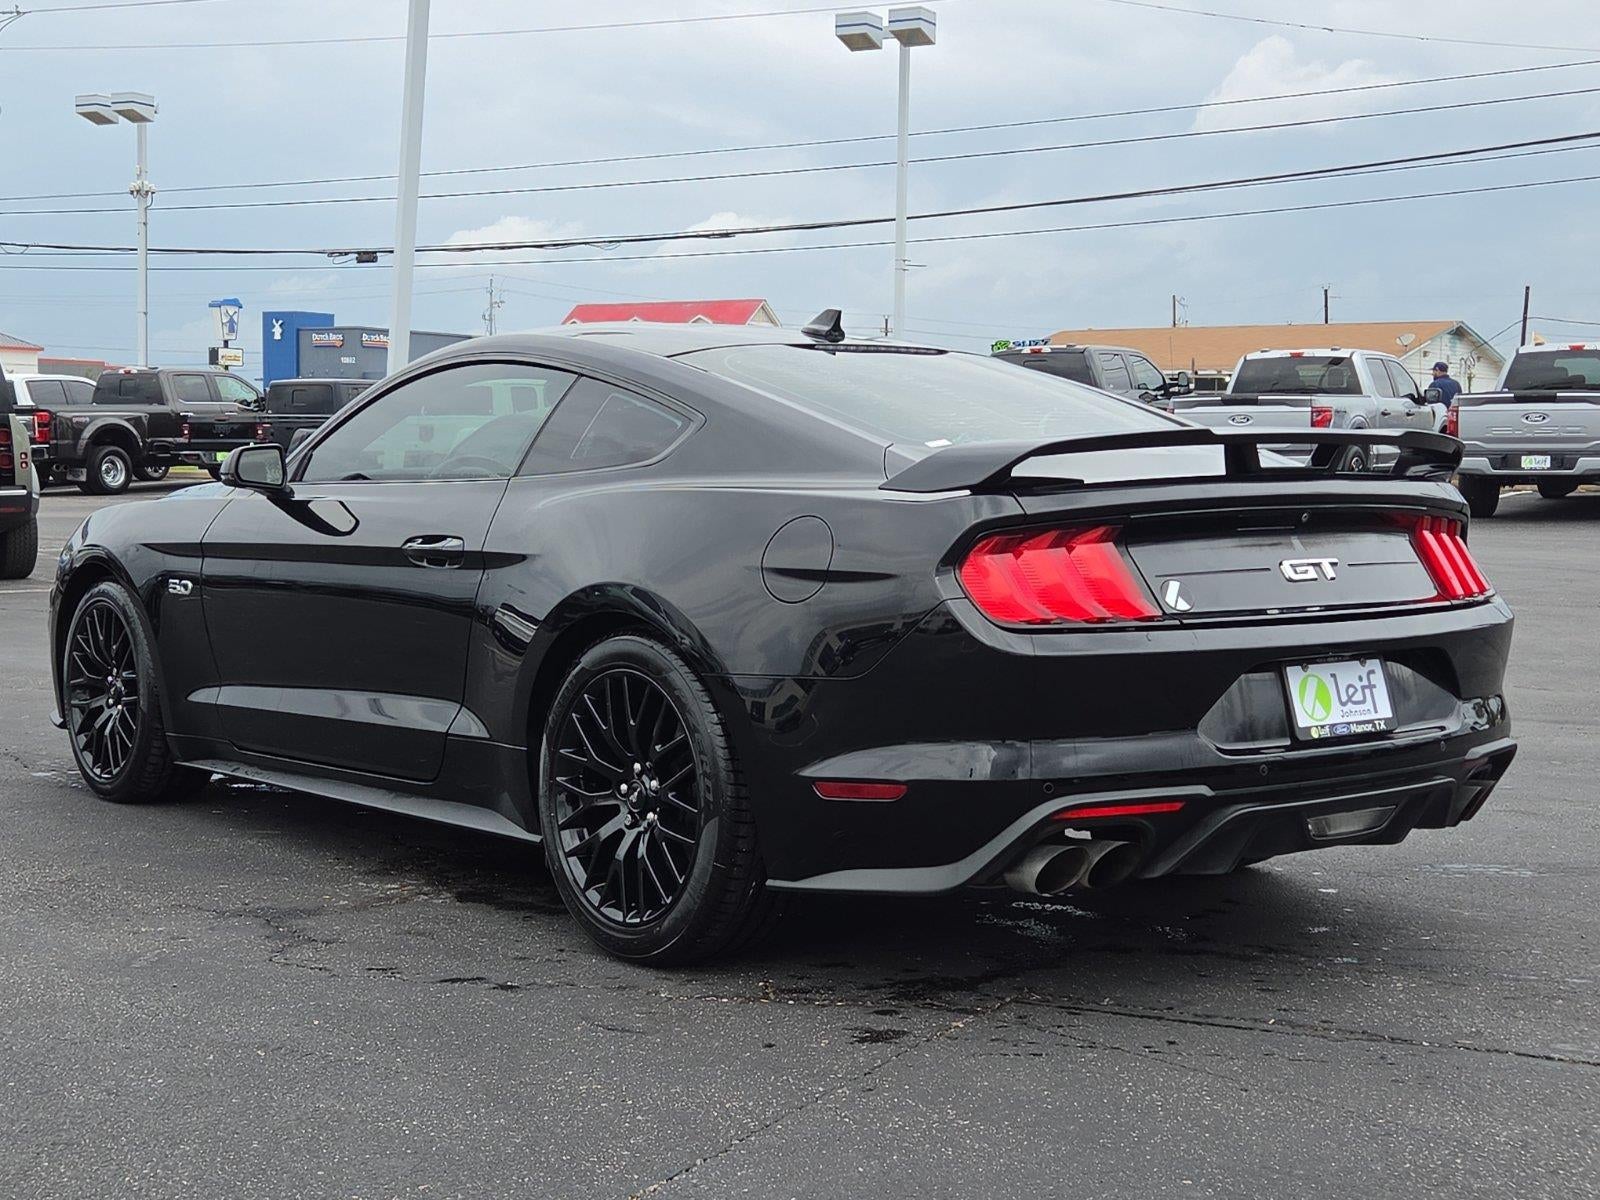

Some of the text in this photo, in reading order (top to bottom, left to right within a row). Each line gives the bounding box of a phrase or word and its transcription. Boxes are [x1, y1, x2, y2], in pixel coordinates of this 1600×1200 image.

[1279, 558, 1339, 582] GT
[1340, 708, 1372, 718] Johnson
[1334, 725, 1349, 733] Ford
[1350, 723, 1374, 733] Manor,
[1374, 720, 1387, 731] TX
